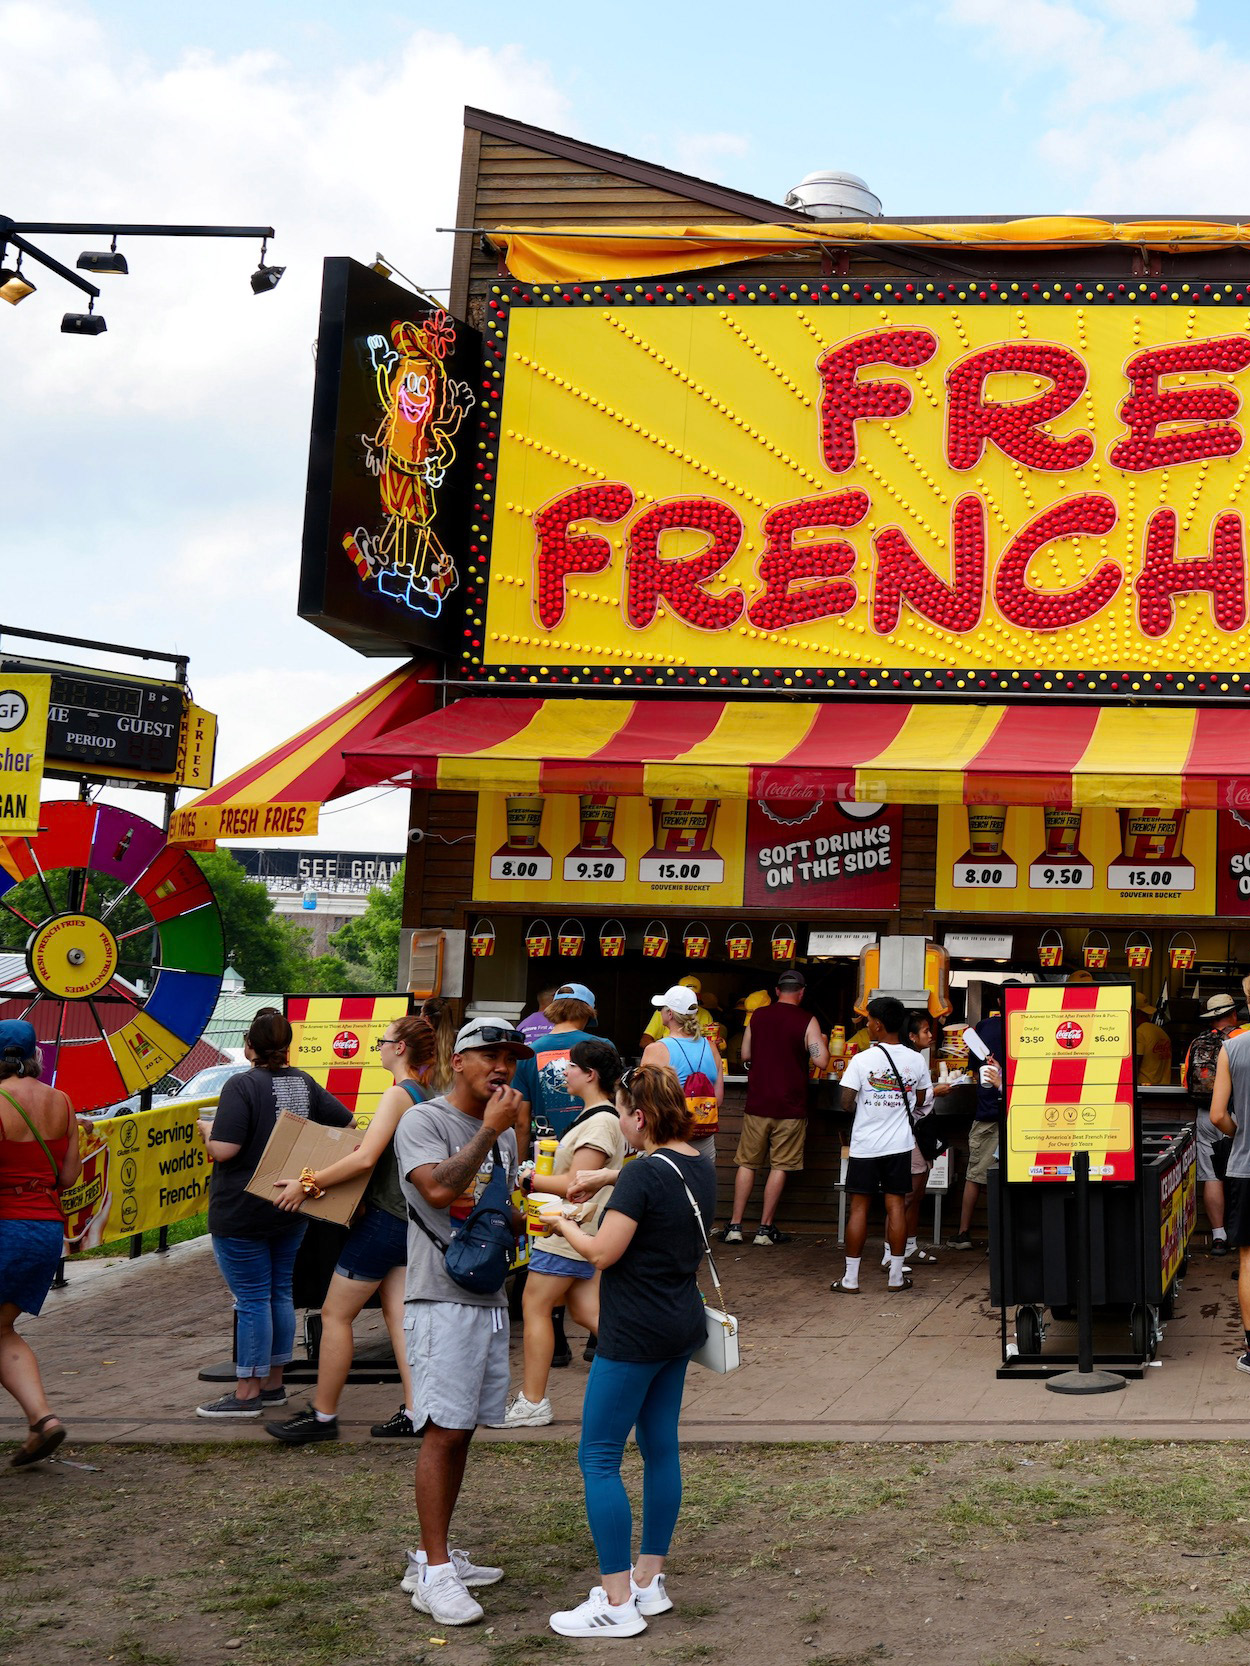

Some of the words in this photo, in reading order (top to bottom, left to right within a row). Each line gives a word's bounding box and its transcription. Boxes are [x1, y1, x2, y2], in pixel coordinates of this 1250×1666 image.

[532, 481, 1250, 640] FRENCH
[148, 691, 156, 701] B
[117, 717, 175, 738] GUEST
[66, 732, 117, 749] PERIOD
[192, 718, 205, 778] FRIES
[219, 808, 259, 835] FRESH
[263, 807, 307, 833] FRIES
[663, 816, 688, 827] FRENCH
[688, 816, 706, 827] FRIES
[1131, 823, 1156, 833] FRENCH
[1157, 823, 1176, 833] FRIES
[758, 840, 811, 867] SOFT
[815, 825, 891, 856] DRINKS
[300, 858, 337, 878] SEE
[351, 860, 402, 879] GRAN
[501, 861, 538, 877] 8.00
[576, 862, 615, 879] 9.50
[658, 864, 701, 879] 15.00
[766, 866, 794, 887] ON
[797, 856, 841, 881] THE
[844, 846, 892, 873] SIDE
[965, 868, 1003, 884] 8.00
[1043, 868, 1083, 885] 9.50
[1128, 871, 1172, 886] 15.00
[1120, 891, 1153, 899] SOUVENIR
[1154, 891, 1182, 899] BUCKET
[38, 923, 61, 954] FRENCH
[61, 919, 86, 929] FRIES
[1019, 1035, 1045, 1044] $3.50
[1056, 1029, 1082, 1040] Coca-Cola
[1094, 1034, 1120, 1042] $6.00
[298, 1045, 322, 1054] $3.50
[147, 1121, 194, 1148] Serving
[159, 1148, 204, 1176] world's
[126, 1168, 132, 1179] V
[84, 1181, 100, 1203] FRIES
[159, 1178, 201, 1208] French
